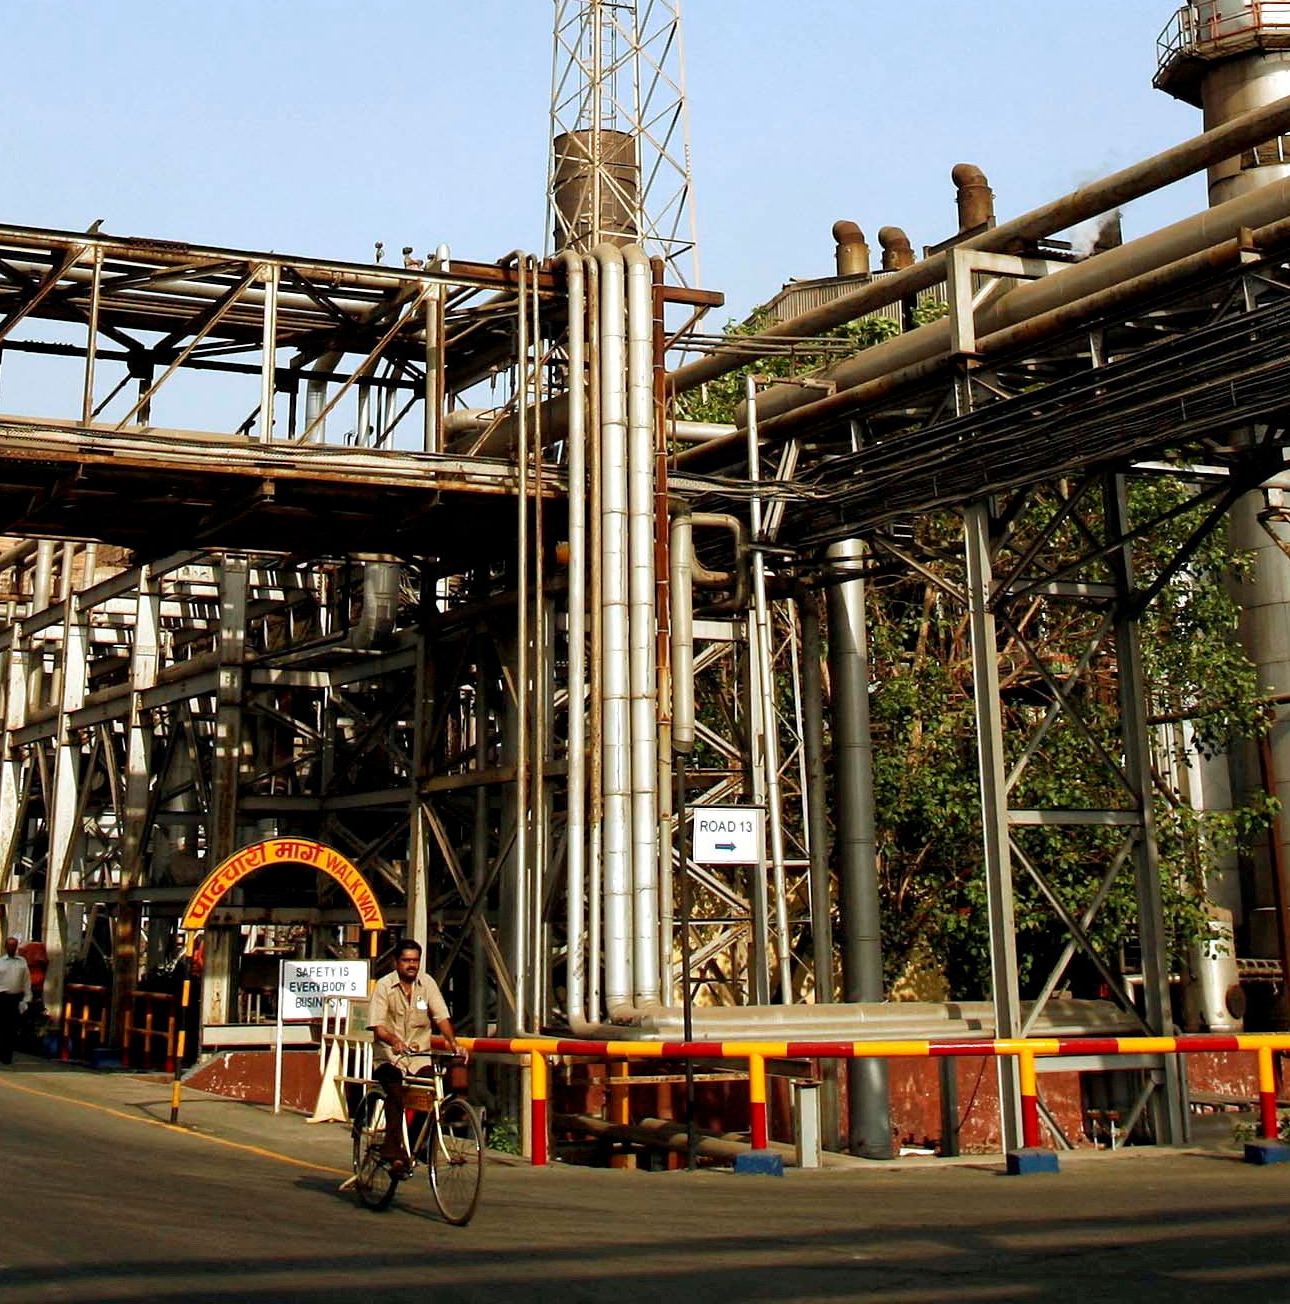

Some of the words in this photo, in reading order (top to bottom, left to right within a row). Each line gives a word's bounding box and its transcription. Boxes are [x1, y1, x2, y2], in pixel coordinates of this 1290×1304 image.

[700, 820, 736, 832] ROAD
[739, 820, 752, 832] 13
[272, 841, 324, 864] मार्ग
[295, 966, 336, 978] SAFETY
[339, 966, 349, 977] IS
